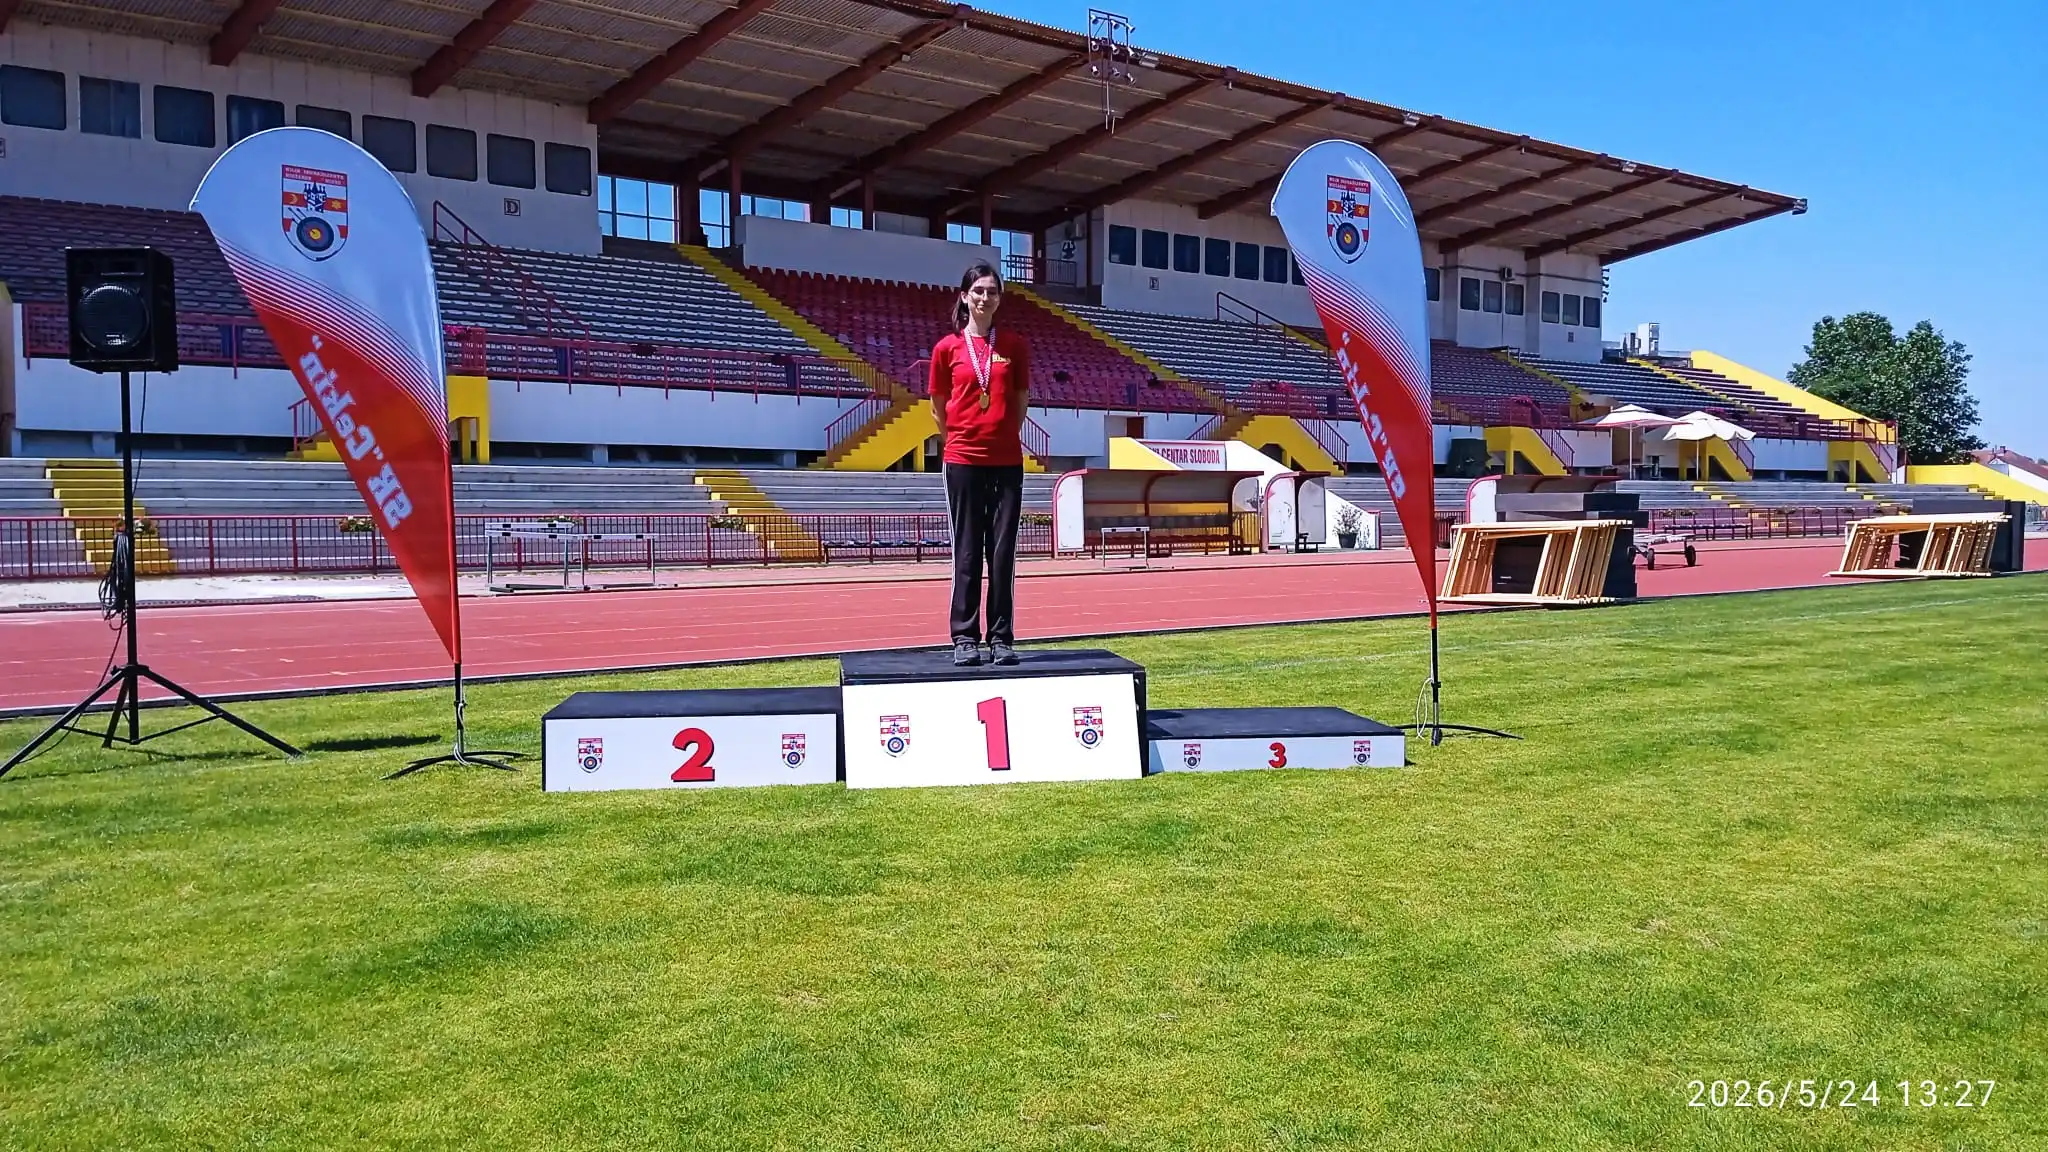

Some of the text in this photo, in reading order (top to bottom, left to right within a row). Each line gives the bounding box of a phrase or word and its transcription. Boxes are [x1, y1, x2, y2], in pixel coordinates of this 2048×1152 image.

[506, 200, 519, 214] D
[1161, 448, 1189, 464] CENTAR
[1189, 448, 1220, 464] SLOBODA
[977, 696, 1011, 771] 1
[670, 727, 716, 783] 2
[1268, 742, 1288, 769] 3
